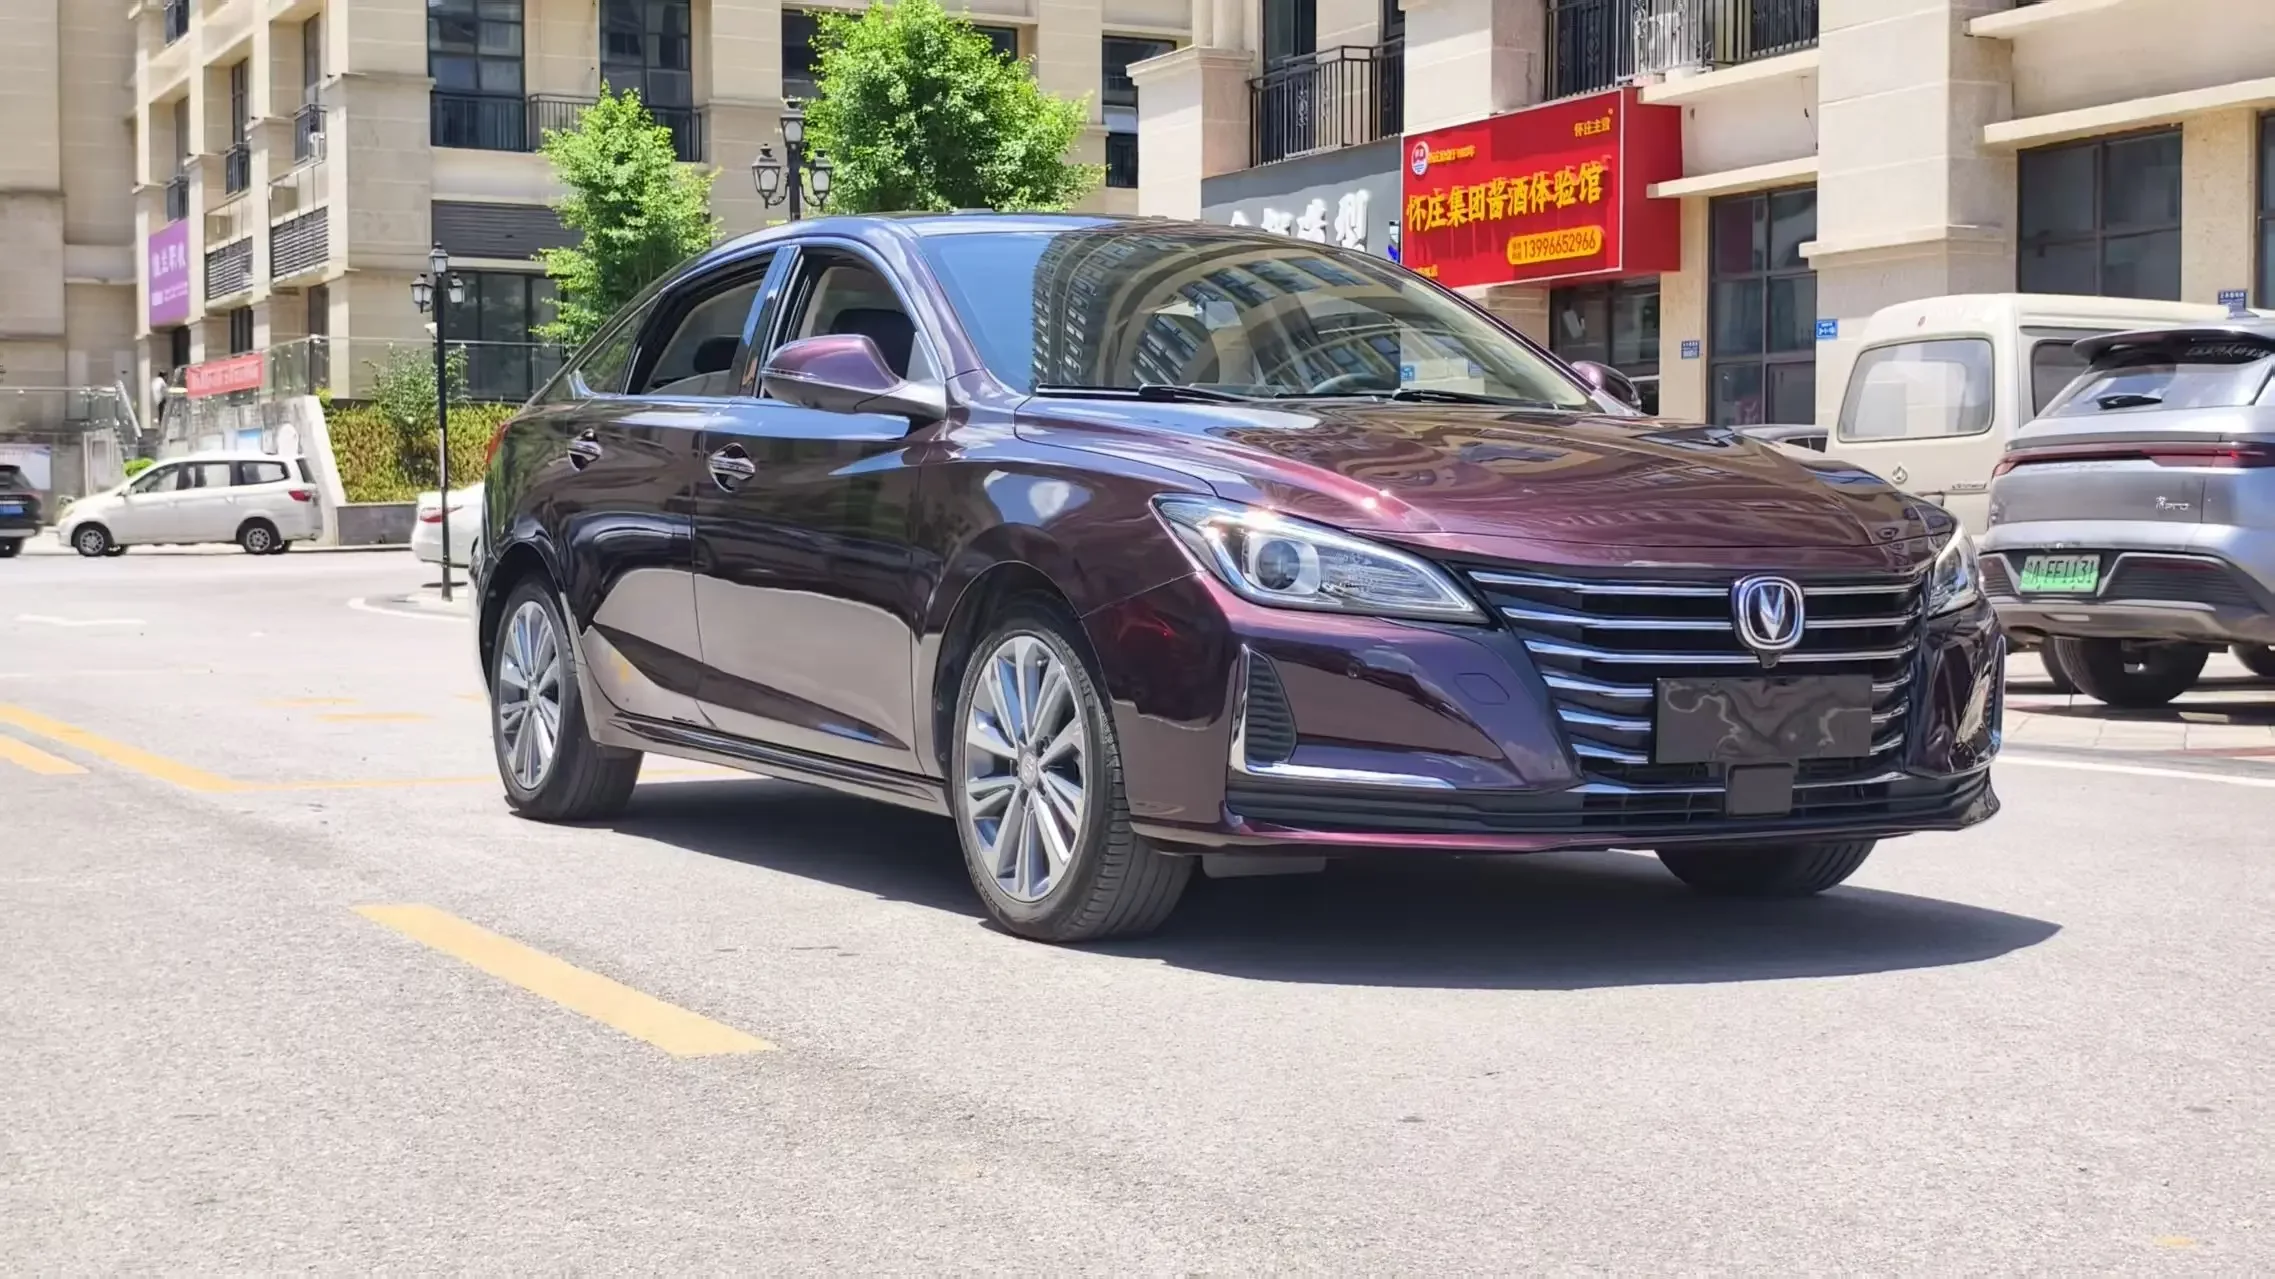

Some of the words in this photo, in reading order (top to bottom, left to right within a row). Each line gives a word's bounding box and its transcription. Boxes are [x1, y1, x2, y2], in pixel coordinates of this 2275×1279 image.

[1406, 160, 1607, 232] 怀庄集团酱酒体验馆
[1523, 229, 1597, 259] 13996652966
